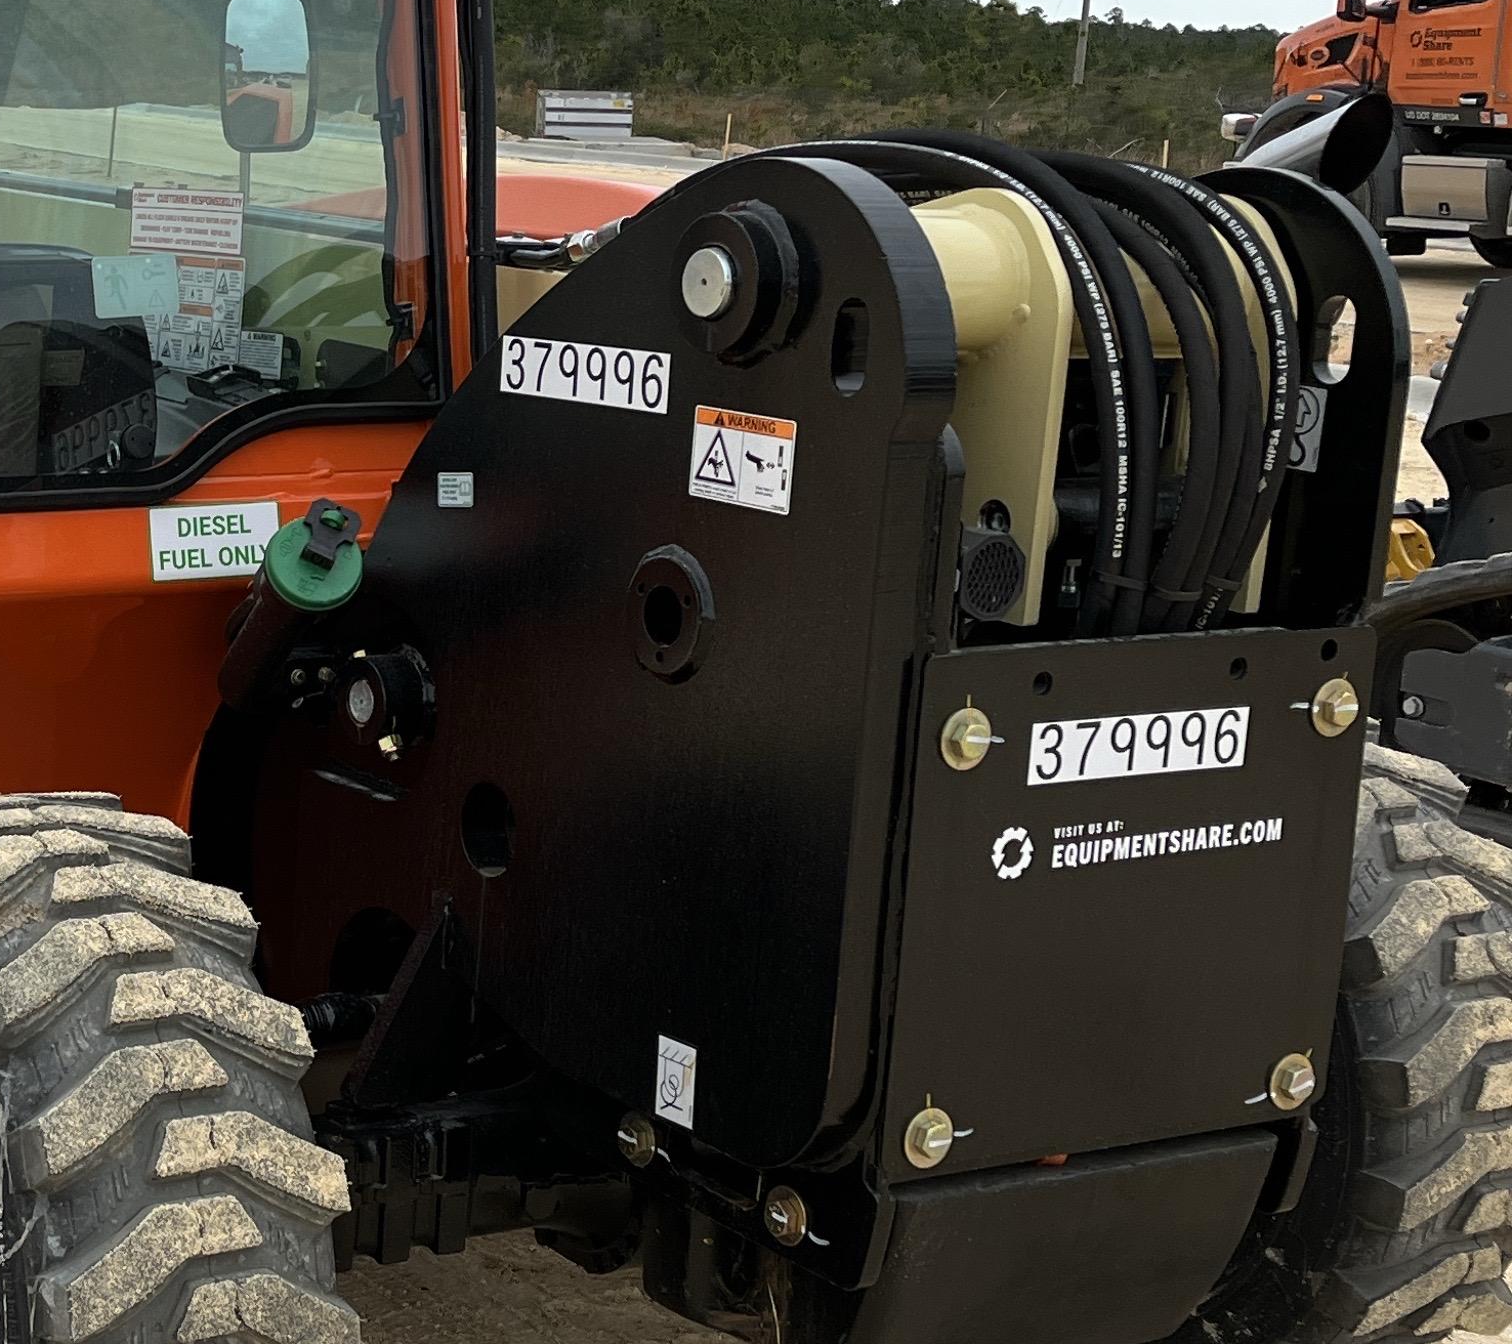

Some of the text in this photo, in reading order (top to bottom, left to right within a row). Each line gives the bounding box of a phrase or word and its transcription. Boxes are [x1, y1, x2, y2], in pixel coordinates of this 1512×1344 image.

[1150, 170, 1187, 190] 100R12
[1185, 185, 1208, 202] SAE
[1207, 199, 1230, 222] BAR)
[1227, 219, 1248, 241] (275
[1064, 234, 1083, 259] 4000
[1242, 240, 1258, 257] WP
[1078, 260, 1093, 280] PSI
[1252, 256, 1268, 276] PSI
[1088, 281, 1101, 301] WP
[1262, 276, 1278, 304] 4000
[1093, 302, 1109, 329] (275
[1103, 332, 1118, 363] BAR)
[506, 338, 664, 408] 379996
[1110, 370, 1124, 396] SAE
[727, 414, 776, 434] WARNING
[1115, 400, 1127, 448] 100R12
[1118, 456, 1128, 495] MSHA
[177, 514, 251, 537] DIESEL
[159, 548, 213, 570] FUEL
[1036, 709, 1241, 779] 379996
[1053, 820, 1125, 839] VISIT US AT:
[1051, 817, 1284, 869] EQUIPMENTSHARE.COM
